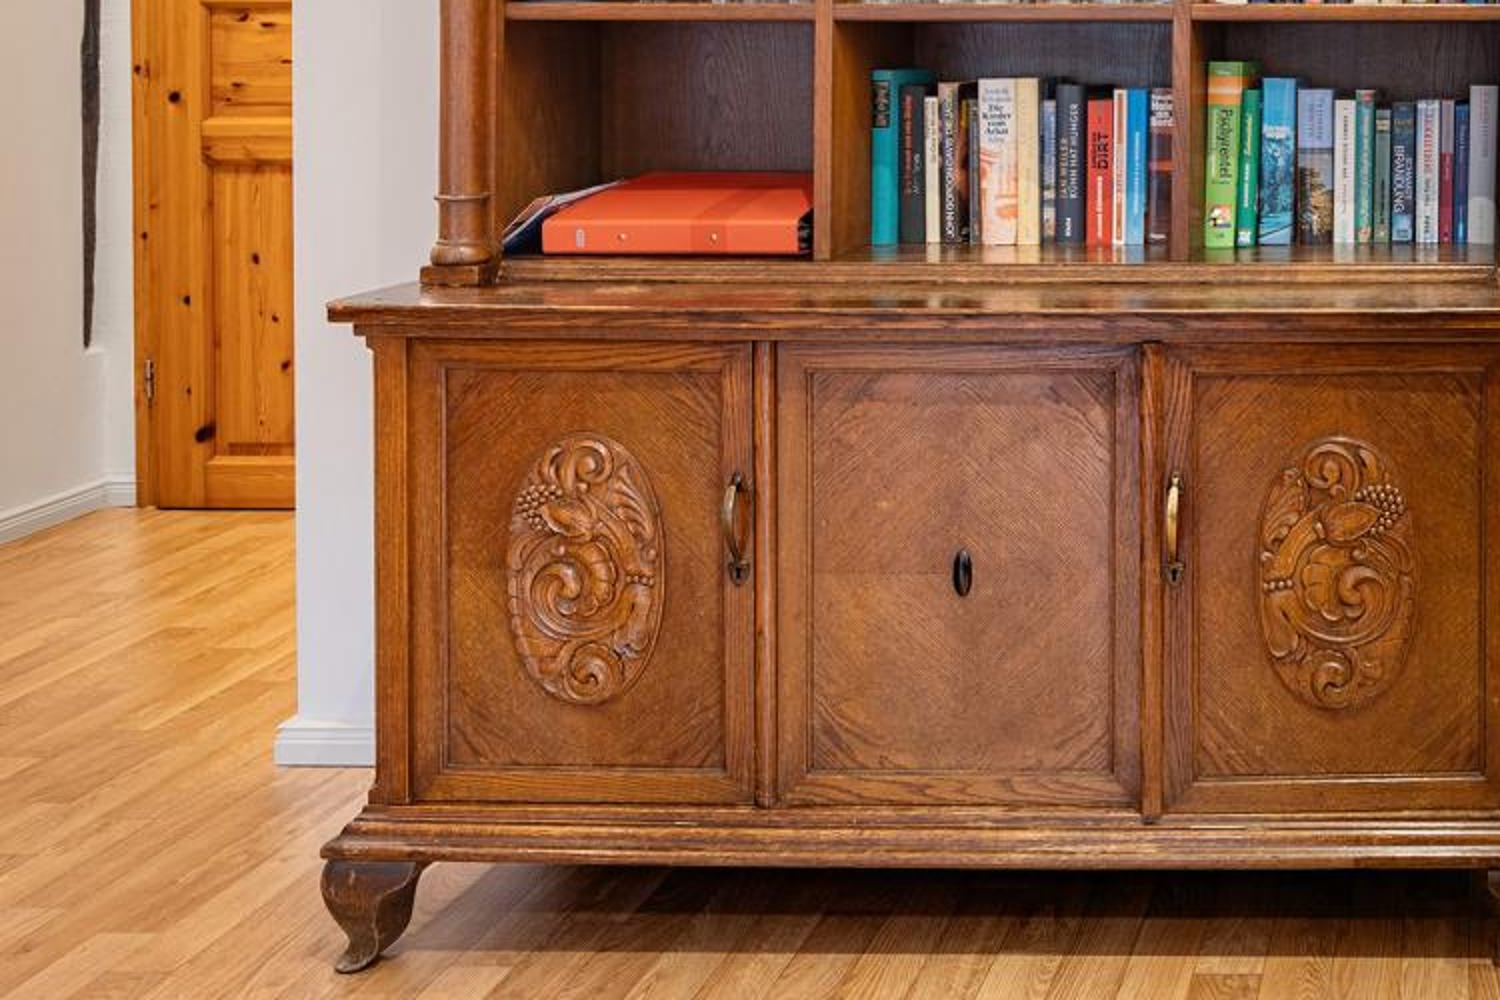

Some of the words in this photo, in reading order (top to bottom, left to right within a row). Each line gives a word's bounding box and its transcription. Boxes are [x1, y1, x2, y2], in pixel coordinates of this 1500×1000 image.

[988, 104, 1005, 112] Die
[1068, 103, 1079, 147] HUNGER
[1068, 148, 1079, 167] HAT
[1098, 131, 1109, 170] DIRT
[1393, 145, 1406, 213] BRANDUNG
[945, 211, 955, 239] JOHN
